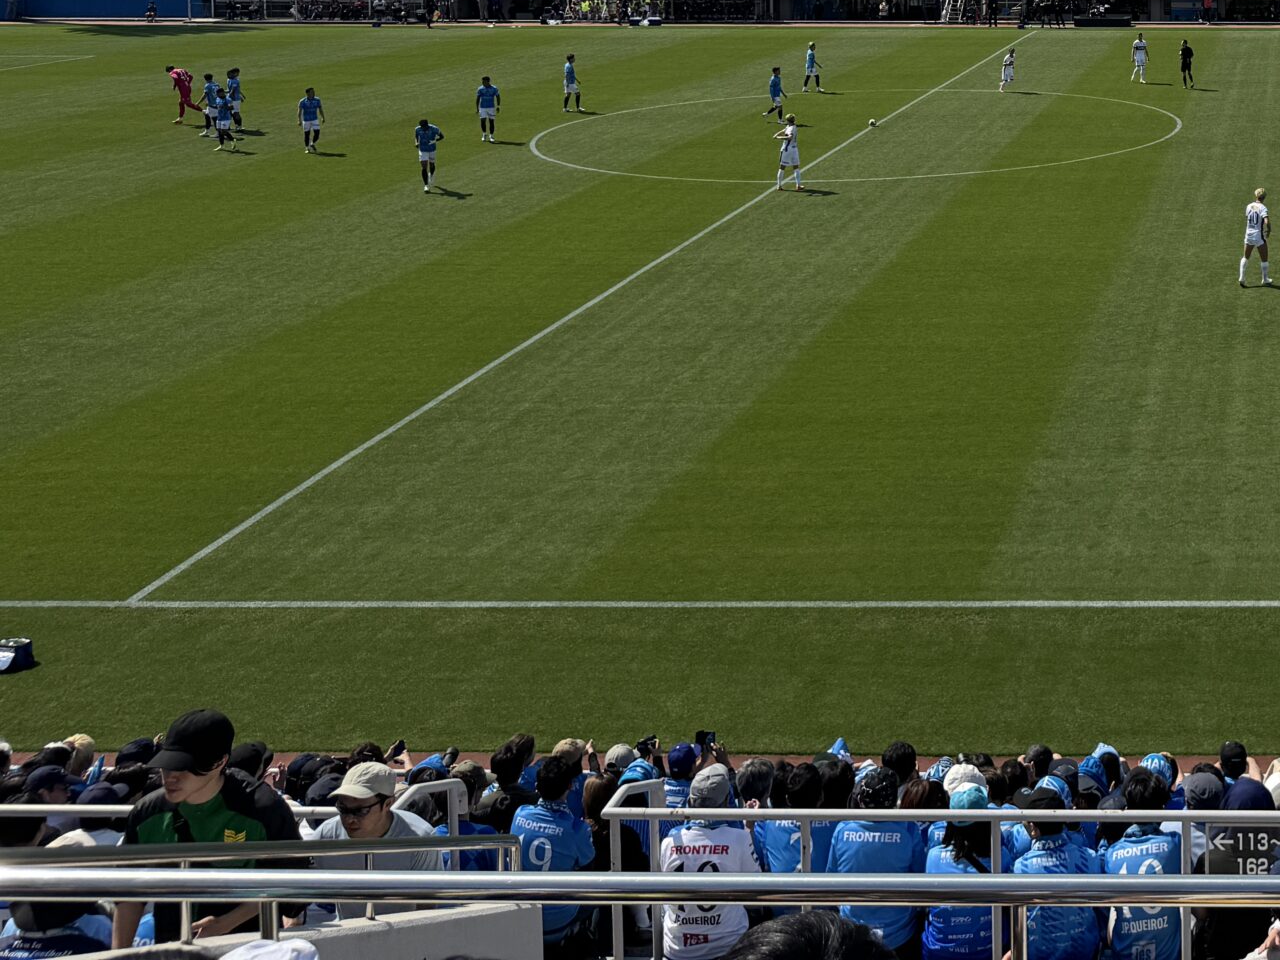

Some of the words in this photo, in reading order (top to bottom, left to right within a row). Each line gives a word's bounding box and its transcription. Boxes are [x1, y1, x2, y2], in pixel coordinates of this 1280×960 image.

[516, 816, 564, 836] FRONTIER
[844, 831, 901, 843] FRONTIER
[671, 845, 730, 855] FRONTIER
[1112, 842, 1169, 861] FRONTIER
[1121, 916, 1168, 934] JP.QUEIROZ
